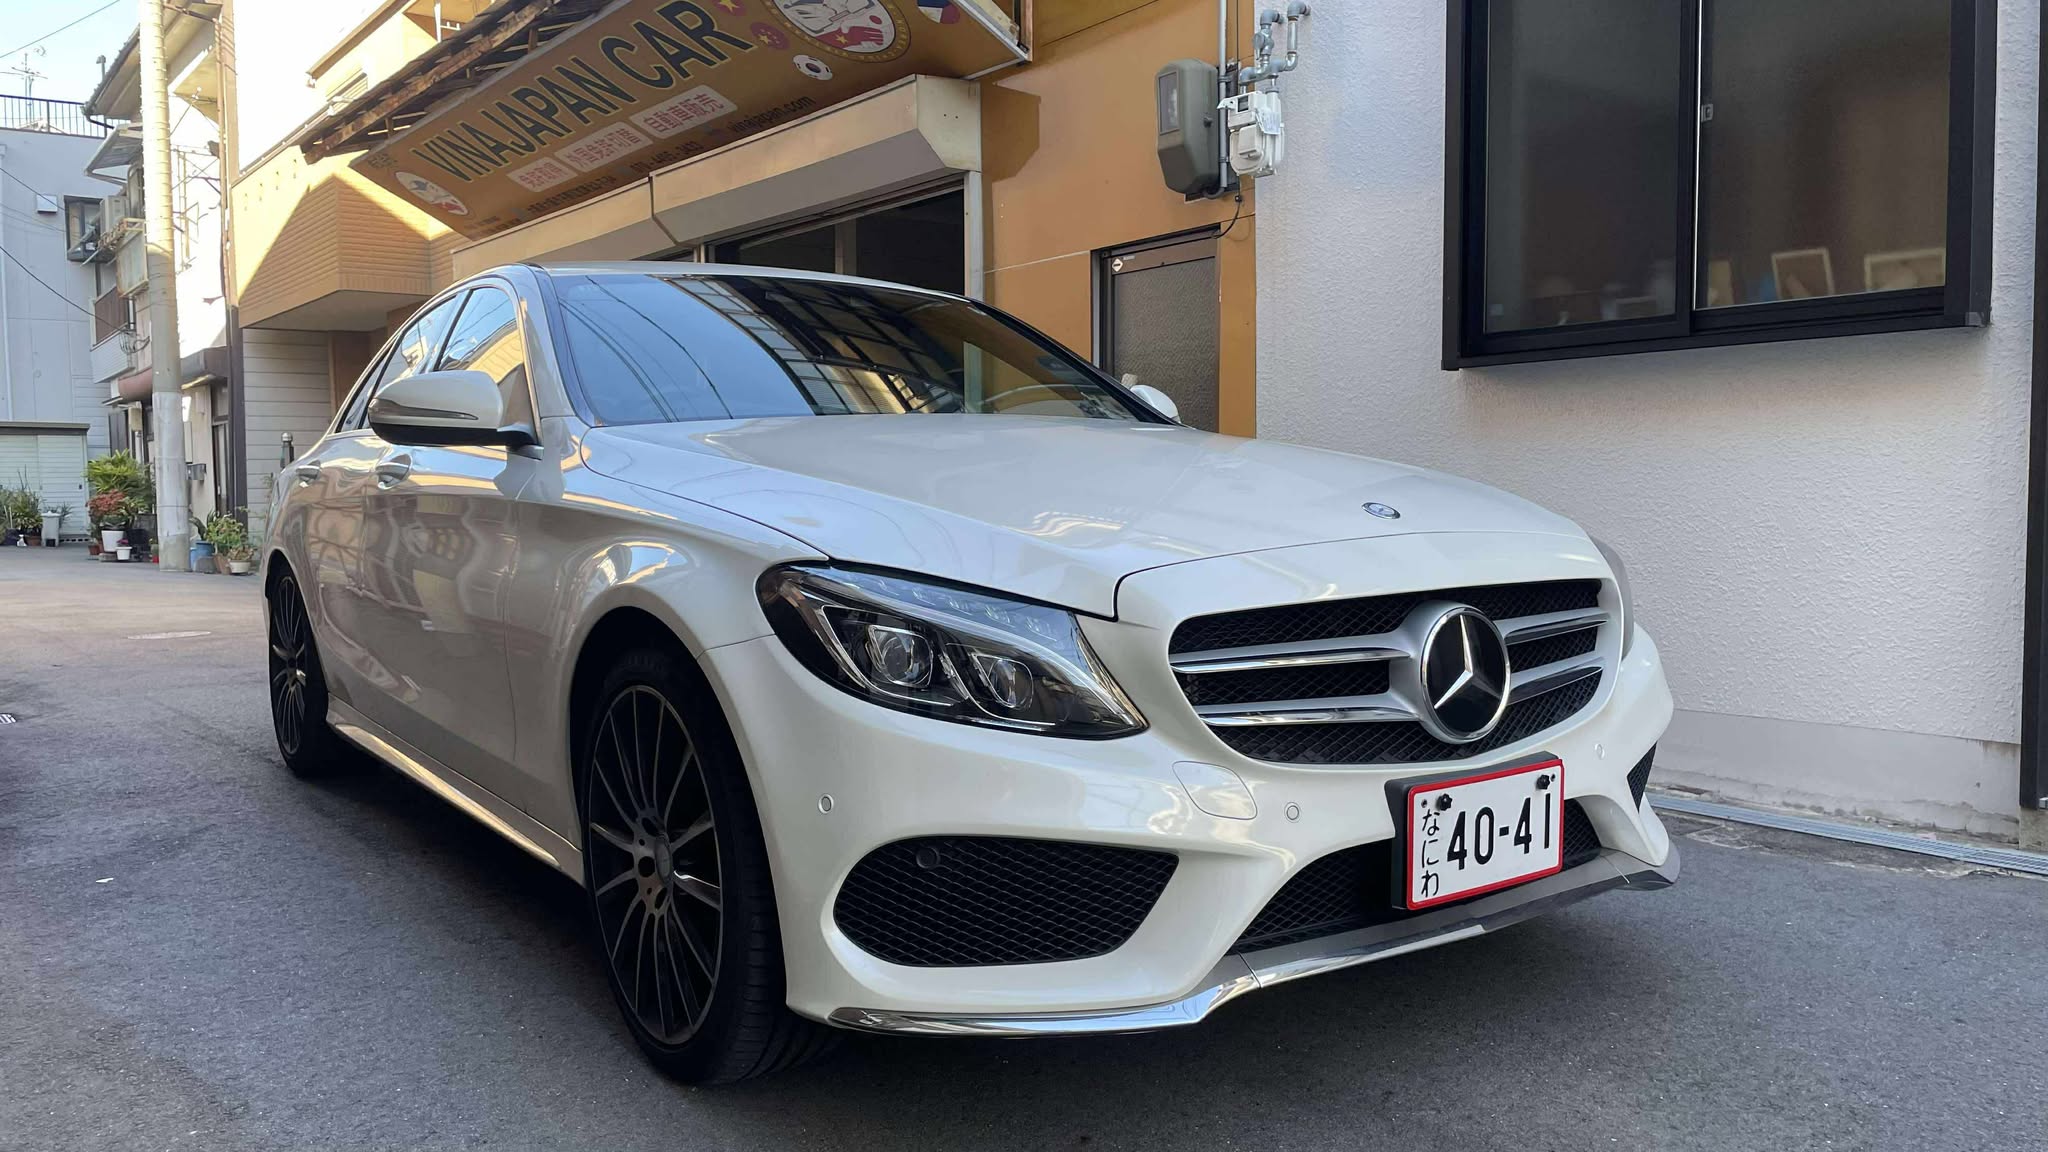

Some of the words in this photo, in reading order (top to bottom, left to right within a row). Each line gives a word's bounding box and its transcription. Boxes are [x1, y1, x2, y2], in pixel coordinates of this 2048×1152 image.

[411, 56, 637, 182] VINAJAPAN
[599, 0, 756, 90] CAR
[644, 93, 725, 132] 自動車販売
[1421, 809, 1440, 897] なにわ
[1447, 793, 1551, 870] 40-41
